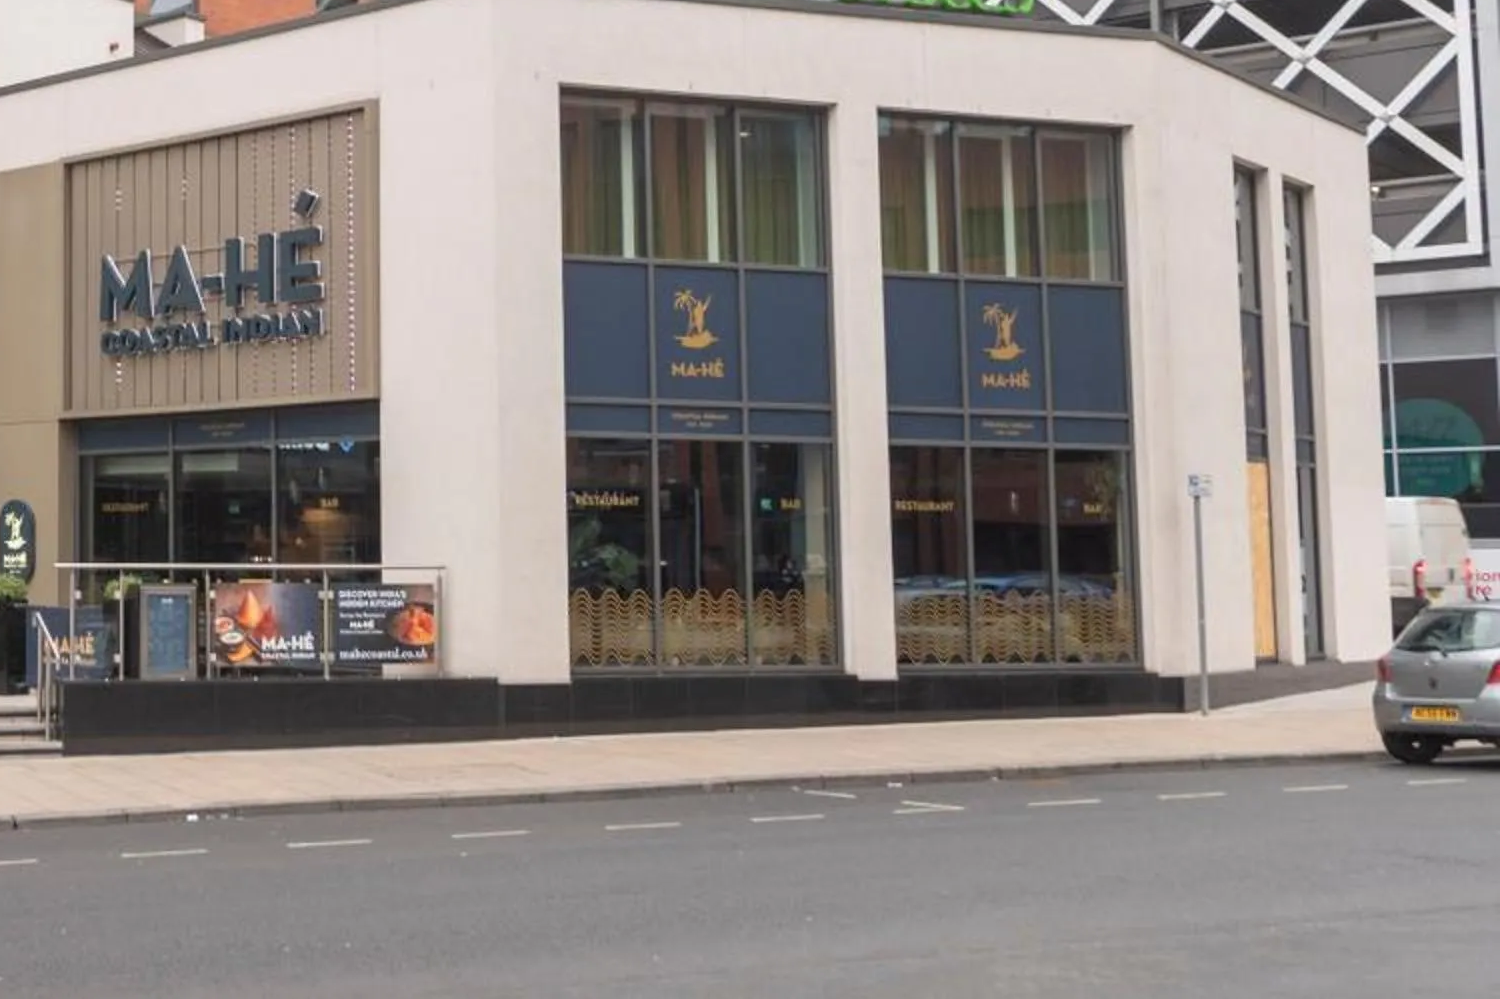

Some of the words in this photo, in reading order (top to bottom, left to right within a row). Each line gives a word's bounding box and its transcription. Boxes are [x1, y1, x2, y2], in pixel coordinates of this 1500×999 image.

[101, 188, 325, 322] MA-HÉ
[102, 319, 218, 356] COASTAL
[221, 307, 325, 344] INDIAN
[671, 357, 725, 378] MA-HÉ
[895, 500, 955, 512] RESTAURANT
[261, 630, 315, 651] MA-HÉ
